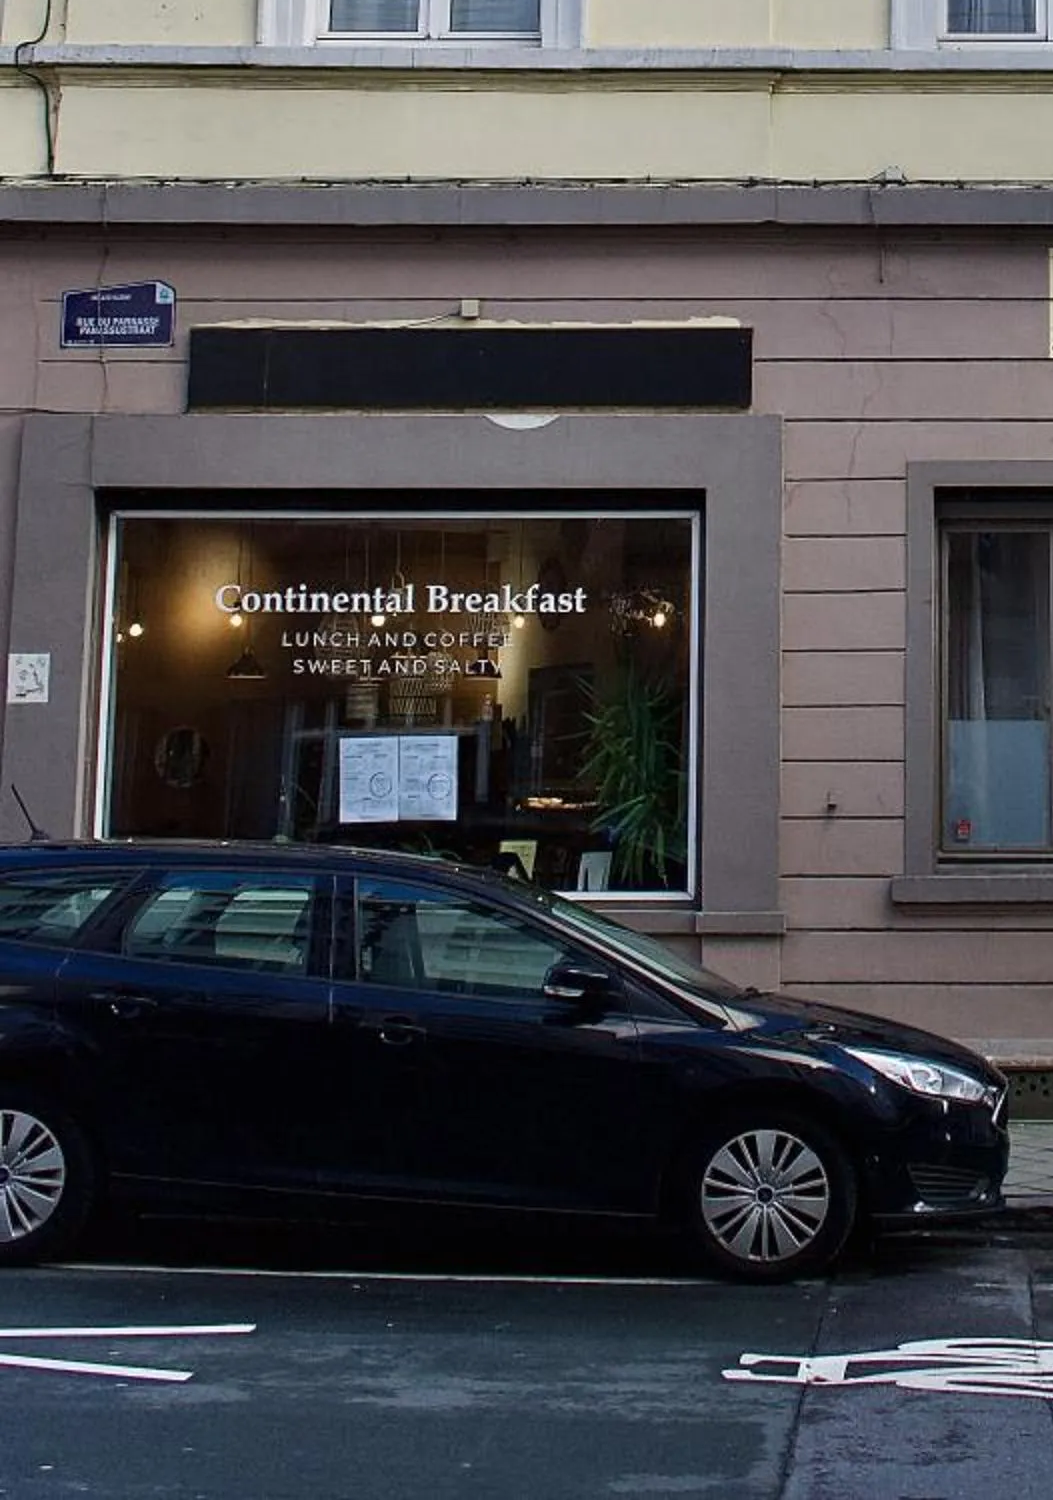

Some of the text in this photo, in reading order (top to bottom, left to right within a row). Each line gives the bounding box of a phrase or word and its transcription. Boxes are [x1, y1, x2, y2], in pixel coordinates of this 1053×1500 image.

[215, 583, 588, 613] Continental Breakfast
[282, 631, 514, 648] LUNCH AND COFFEE
[293, 659, 503, 675] SWEET AND SALTY
